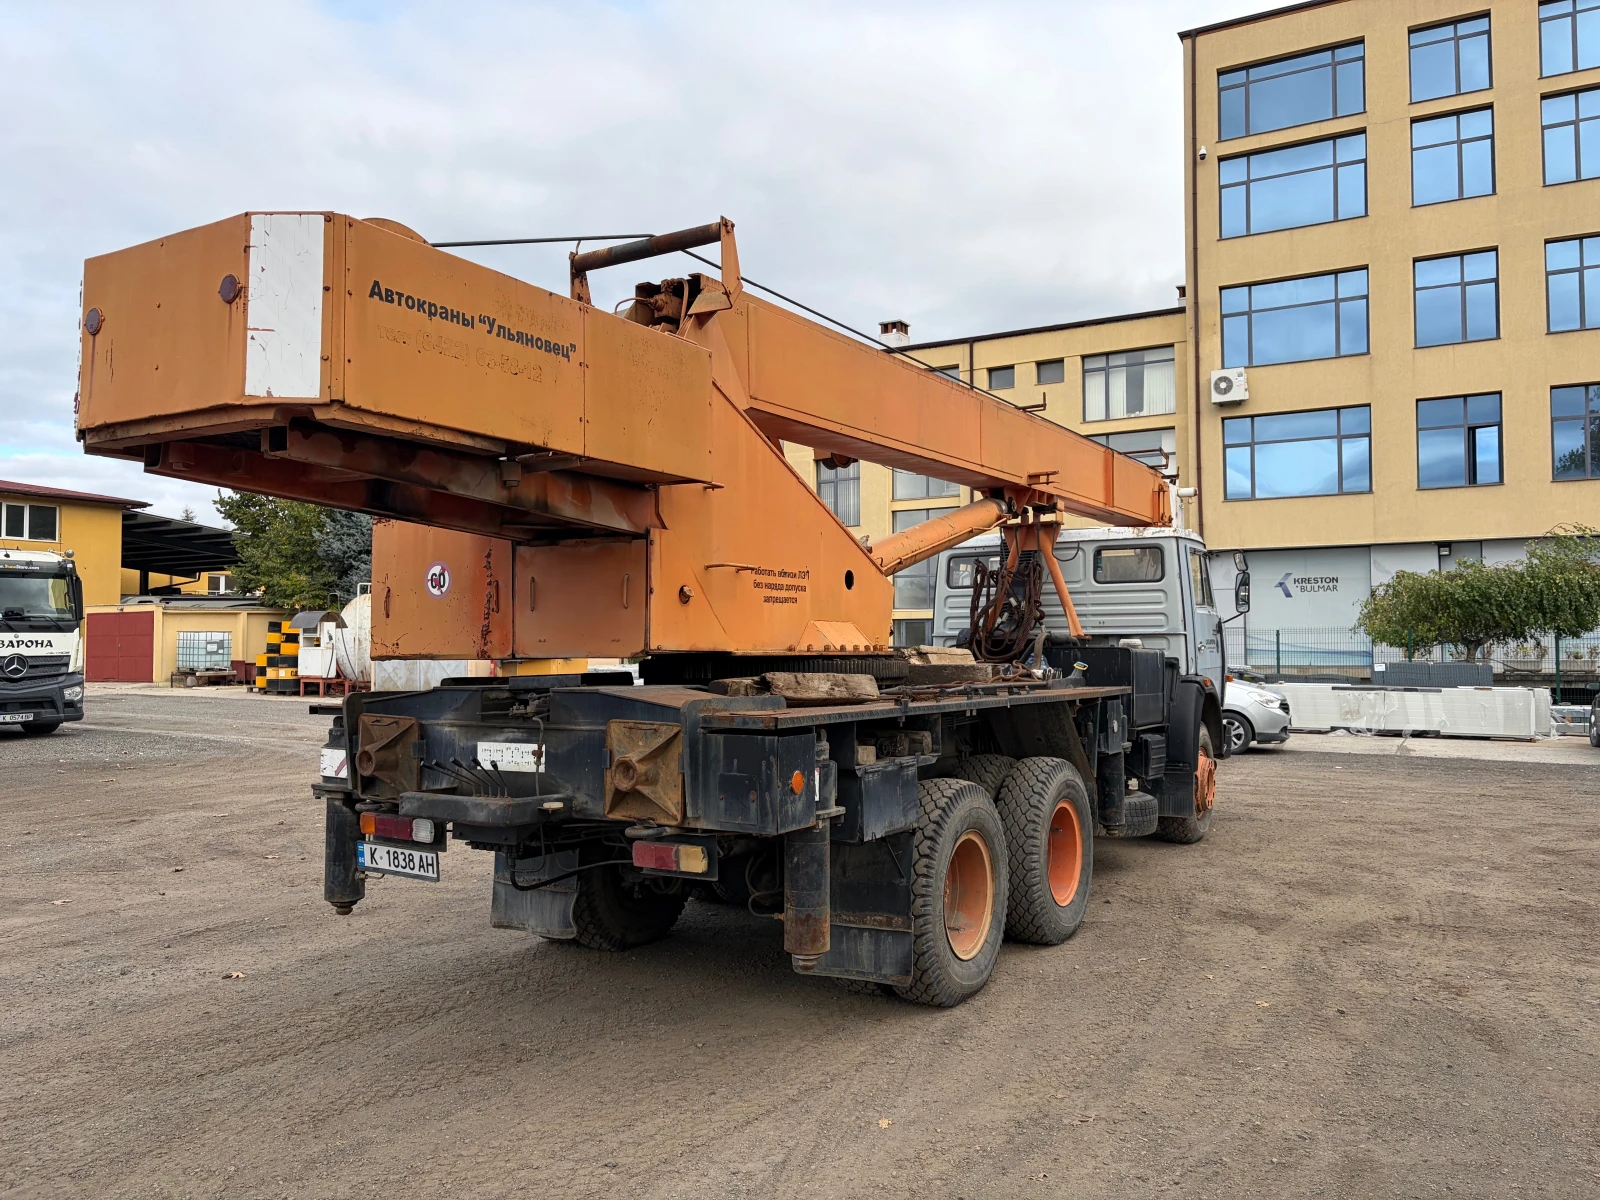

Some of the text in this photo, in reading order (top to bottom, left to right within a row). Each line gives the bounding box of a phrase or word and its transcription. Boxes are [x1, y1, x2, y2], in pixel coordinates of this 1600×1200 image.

[368, 279, 475, 330] Автокраны
[753, 579, 807, 593] без наряда допуска
[1293, 576, 1339, 585] KRESTON
[1300, 584, 1339, 593] BULMAR
[763, 596, 798, 605] запрещается
[369, 846, 435, 875] K 1838 AH
